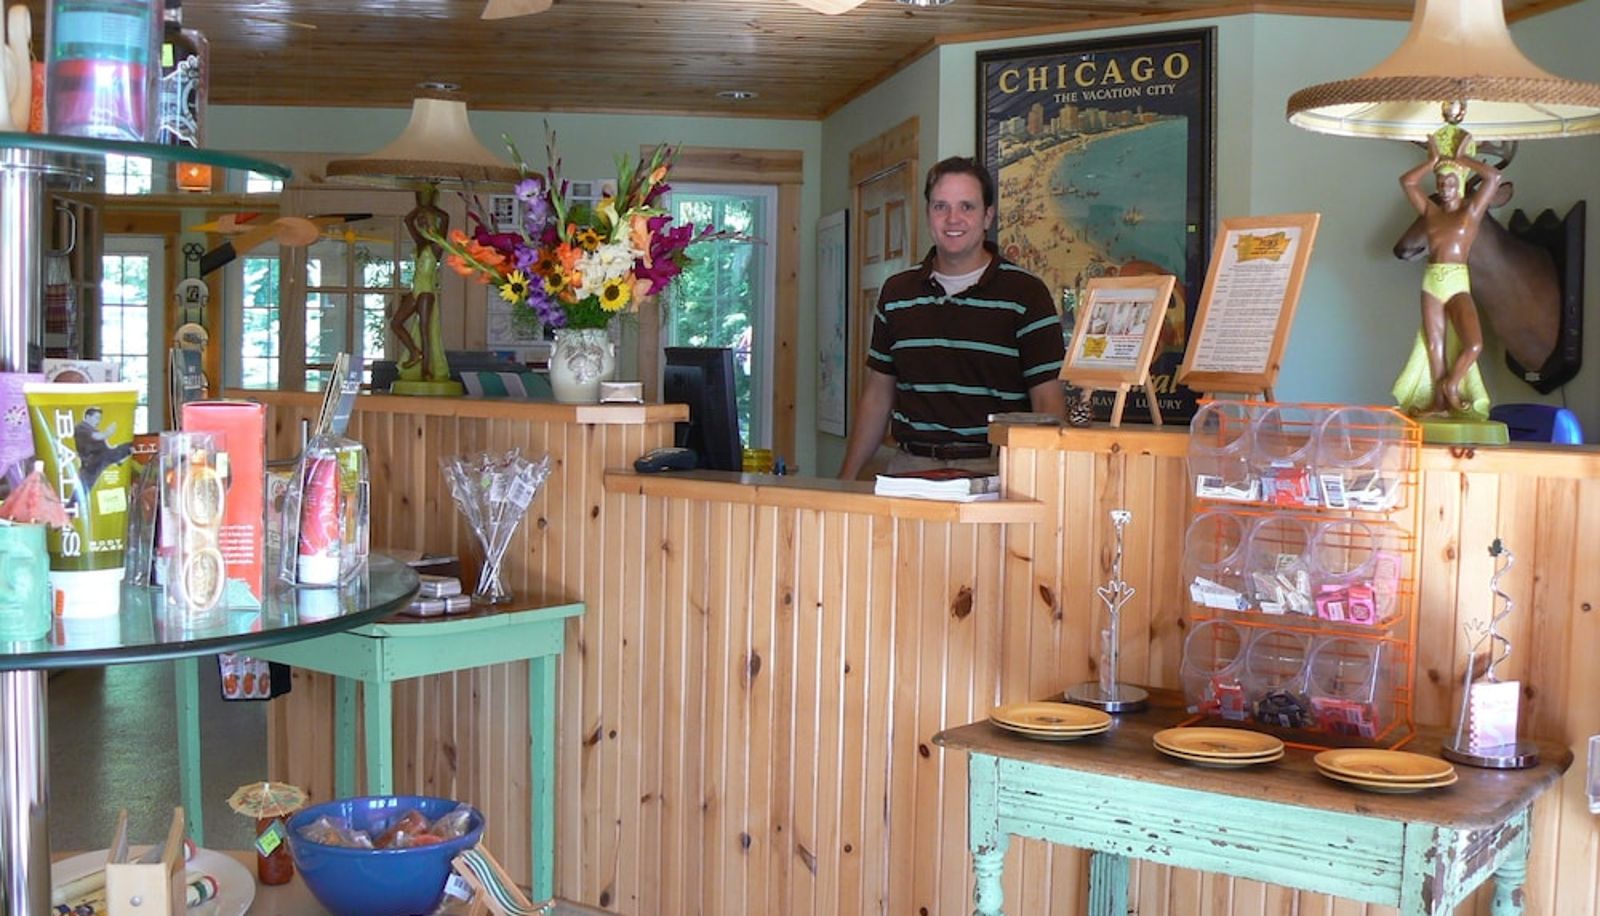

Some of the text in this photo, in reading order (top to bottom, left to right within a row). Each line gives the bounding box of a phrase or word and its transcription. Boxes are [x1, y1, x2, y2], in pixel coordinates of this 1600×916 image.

[998, 52, 1190, 94] CHICAGO
[1053, 83, 1176, 103] THE VACATION CITY
[1136, 398, 1182, 410] LUURY
